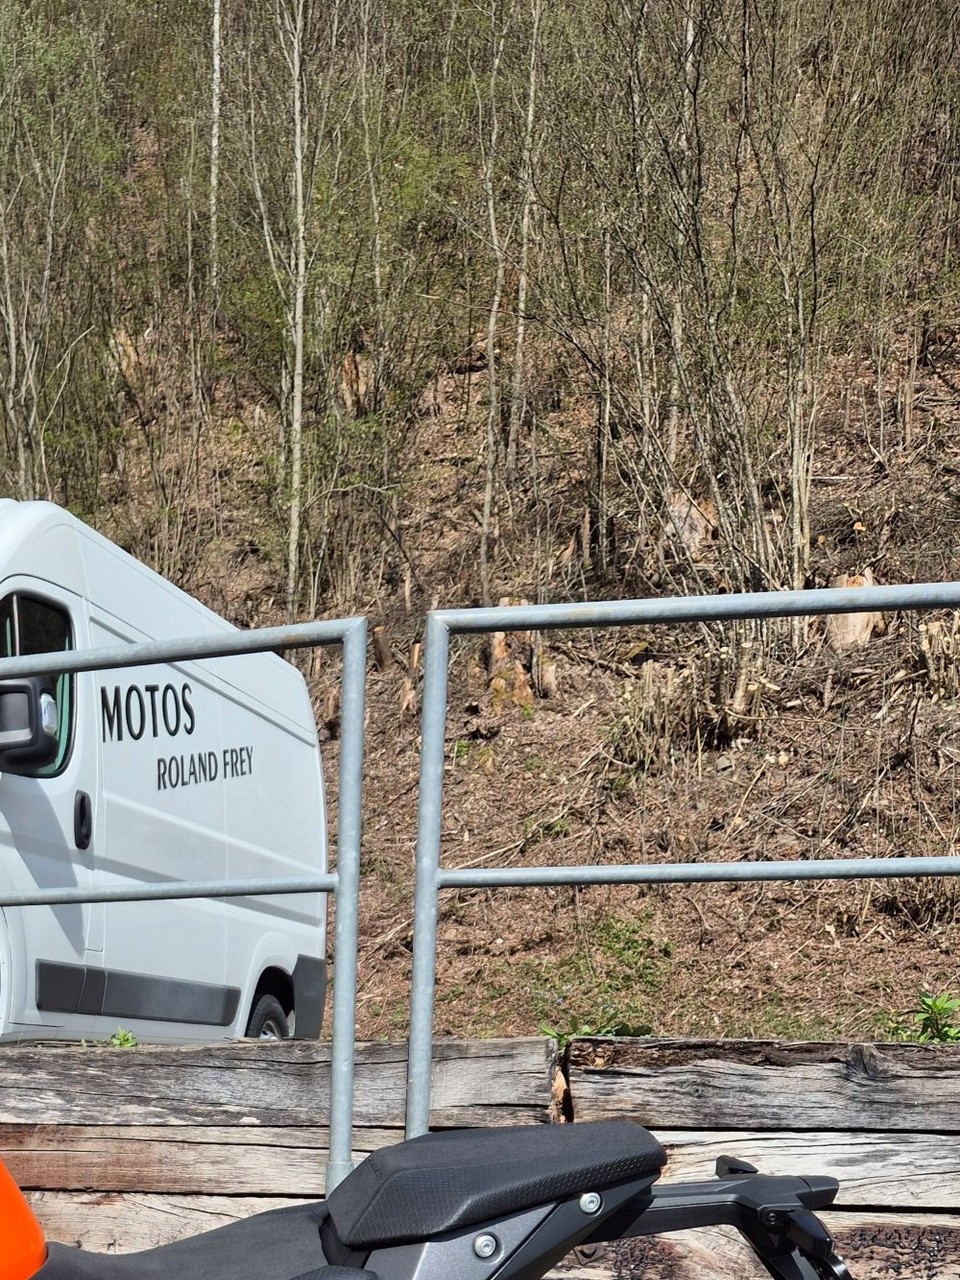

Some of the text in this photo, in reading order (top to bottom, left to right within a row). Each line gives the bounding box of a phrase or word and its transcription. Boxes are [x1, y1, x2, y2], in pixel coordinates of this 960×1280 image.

[101, 682, 196, 743] MOTOS
[157, 745, 254, 790] ROLAND FREY
